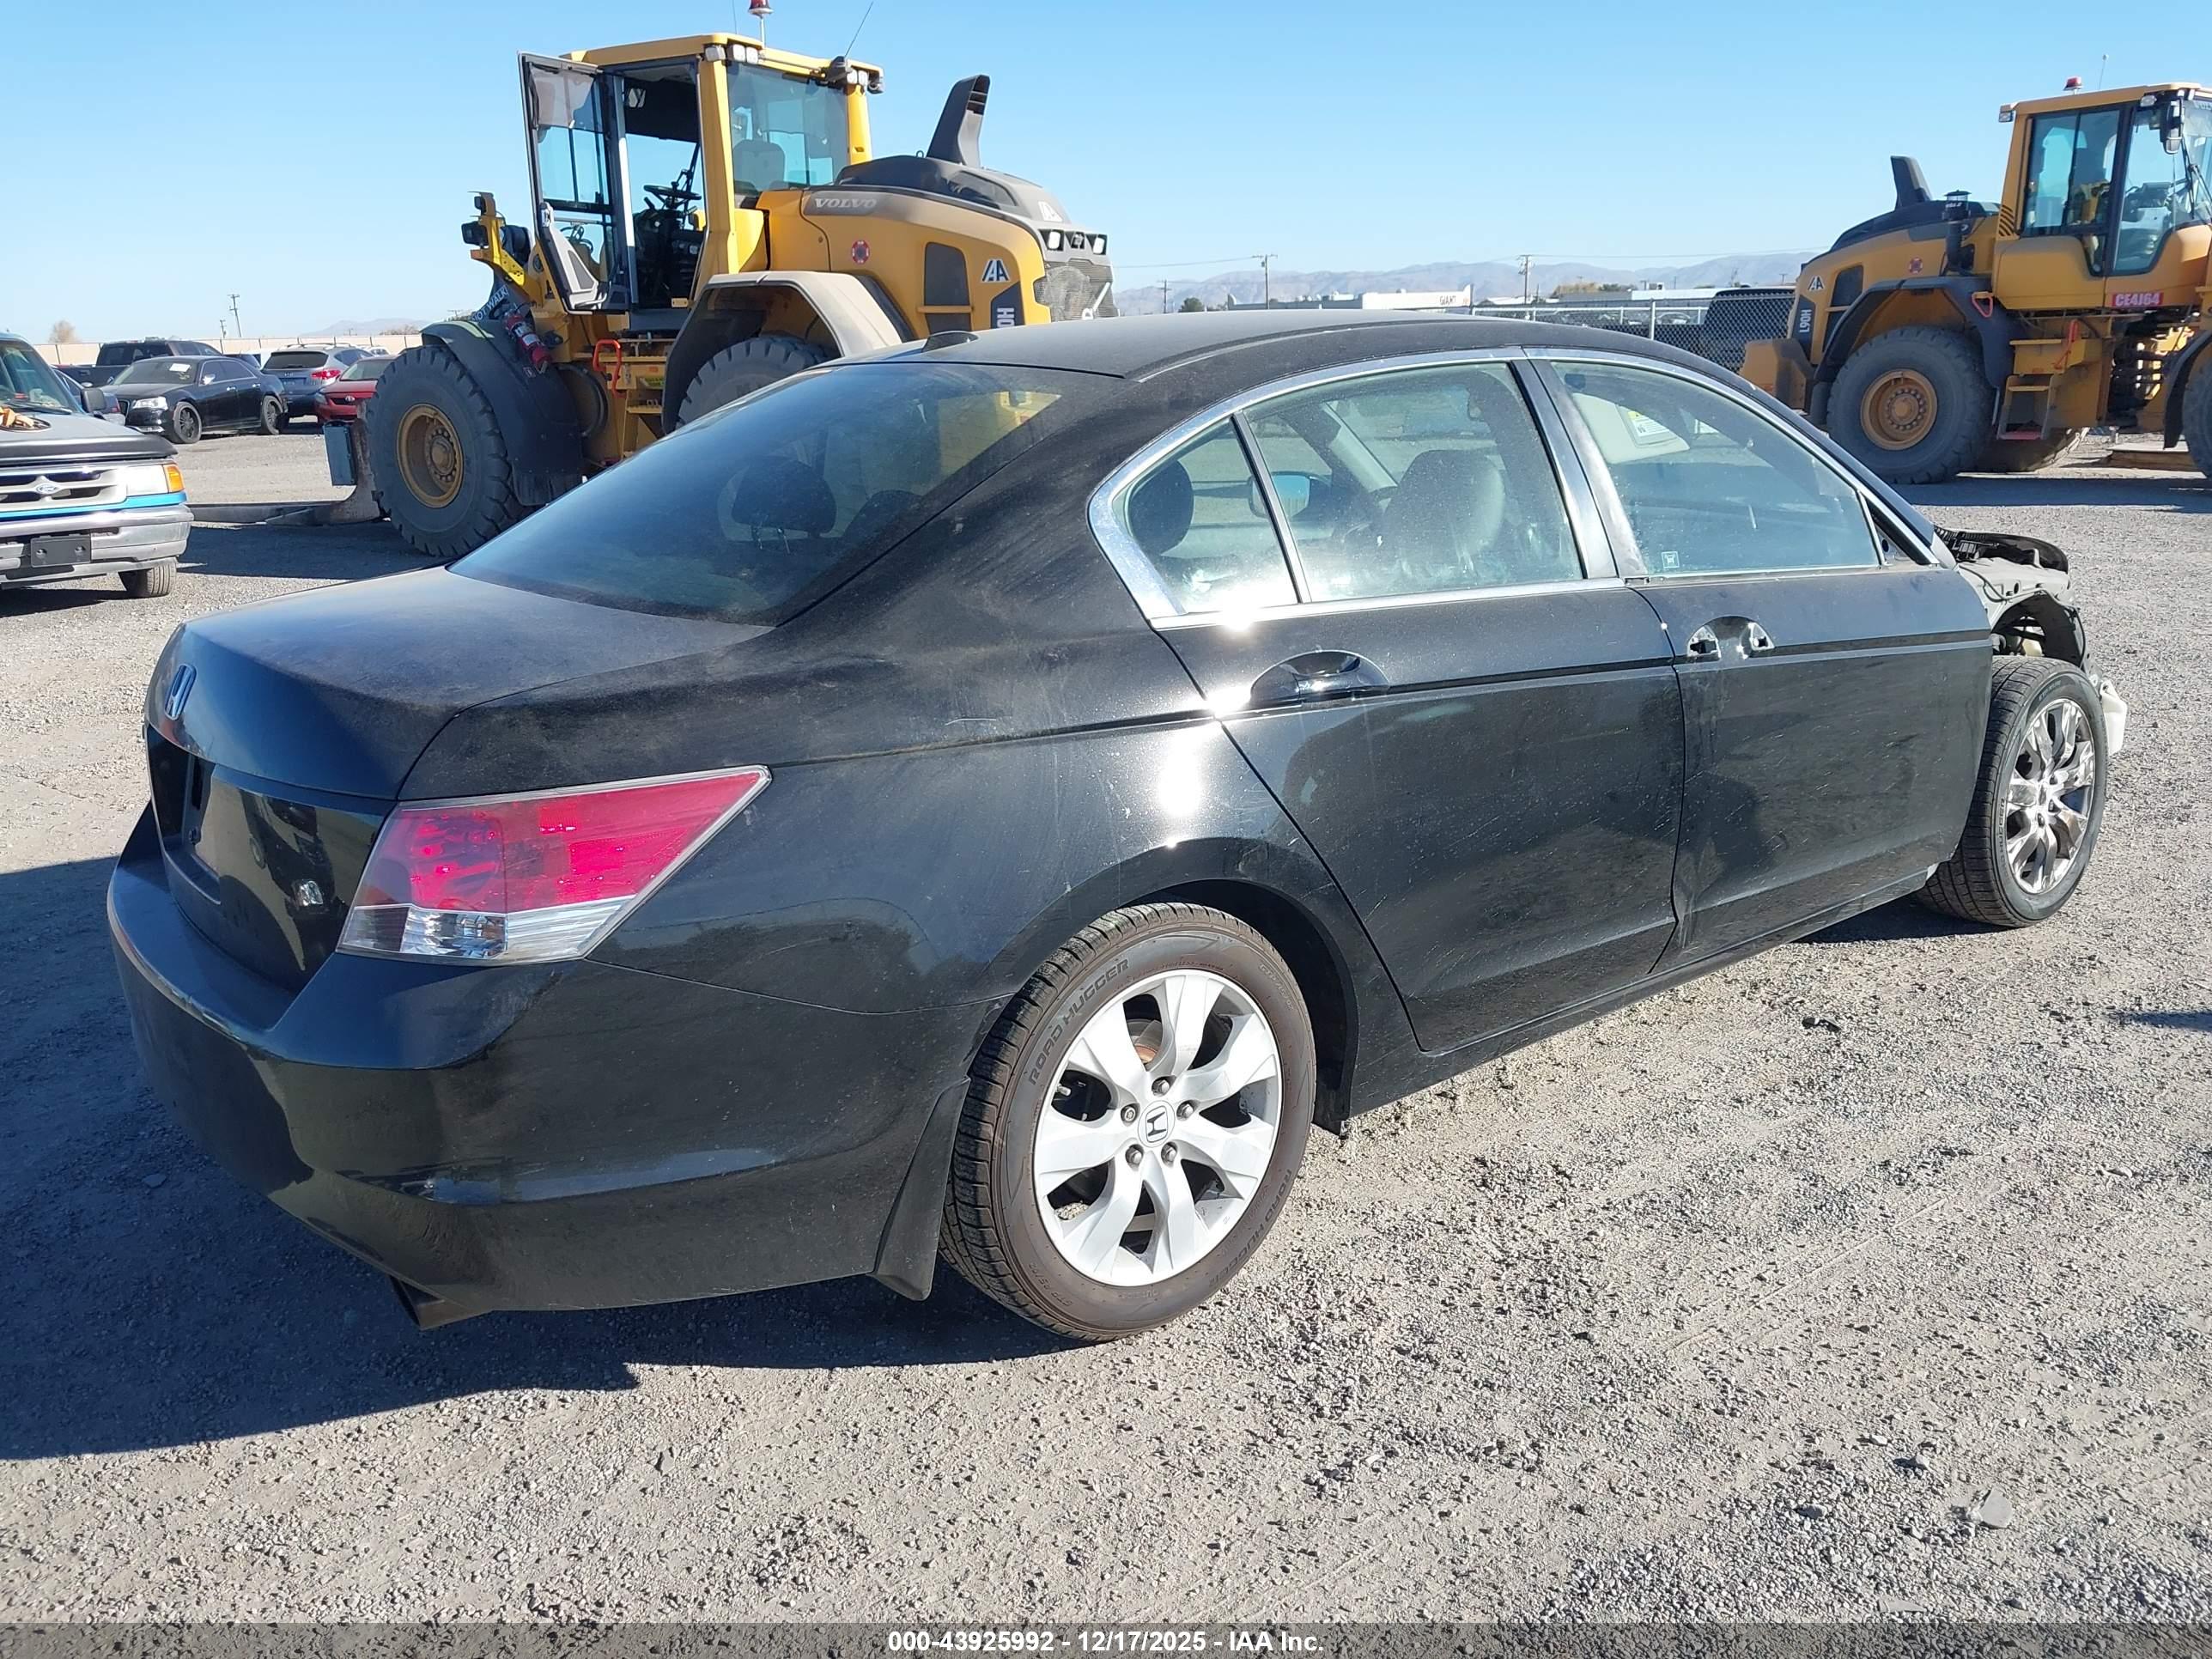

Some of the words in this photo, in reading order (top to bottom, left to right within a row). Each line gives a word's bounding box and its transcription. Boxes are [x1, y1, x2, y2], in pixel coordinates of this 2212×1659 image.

[815, 198, 877, 208] VOLVO
[1799, 309, 1813, 333] L90H
[1029, 1024, 1063, 1085] ROAD
[1063, 958, 1129, 1025] HUGGER
